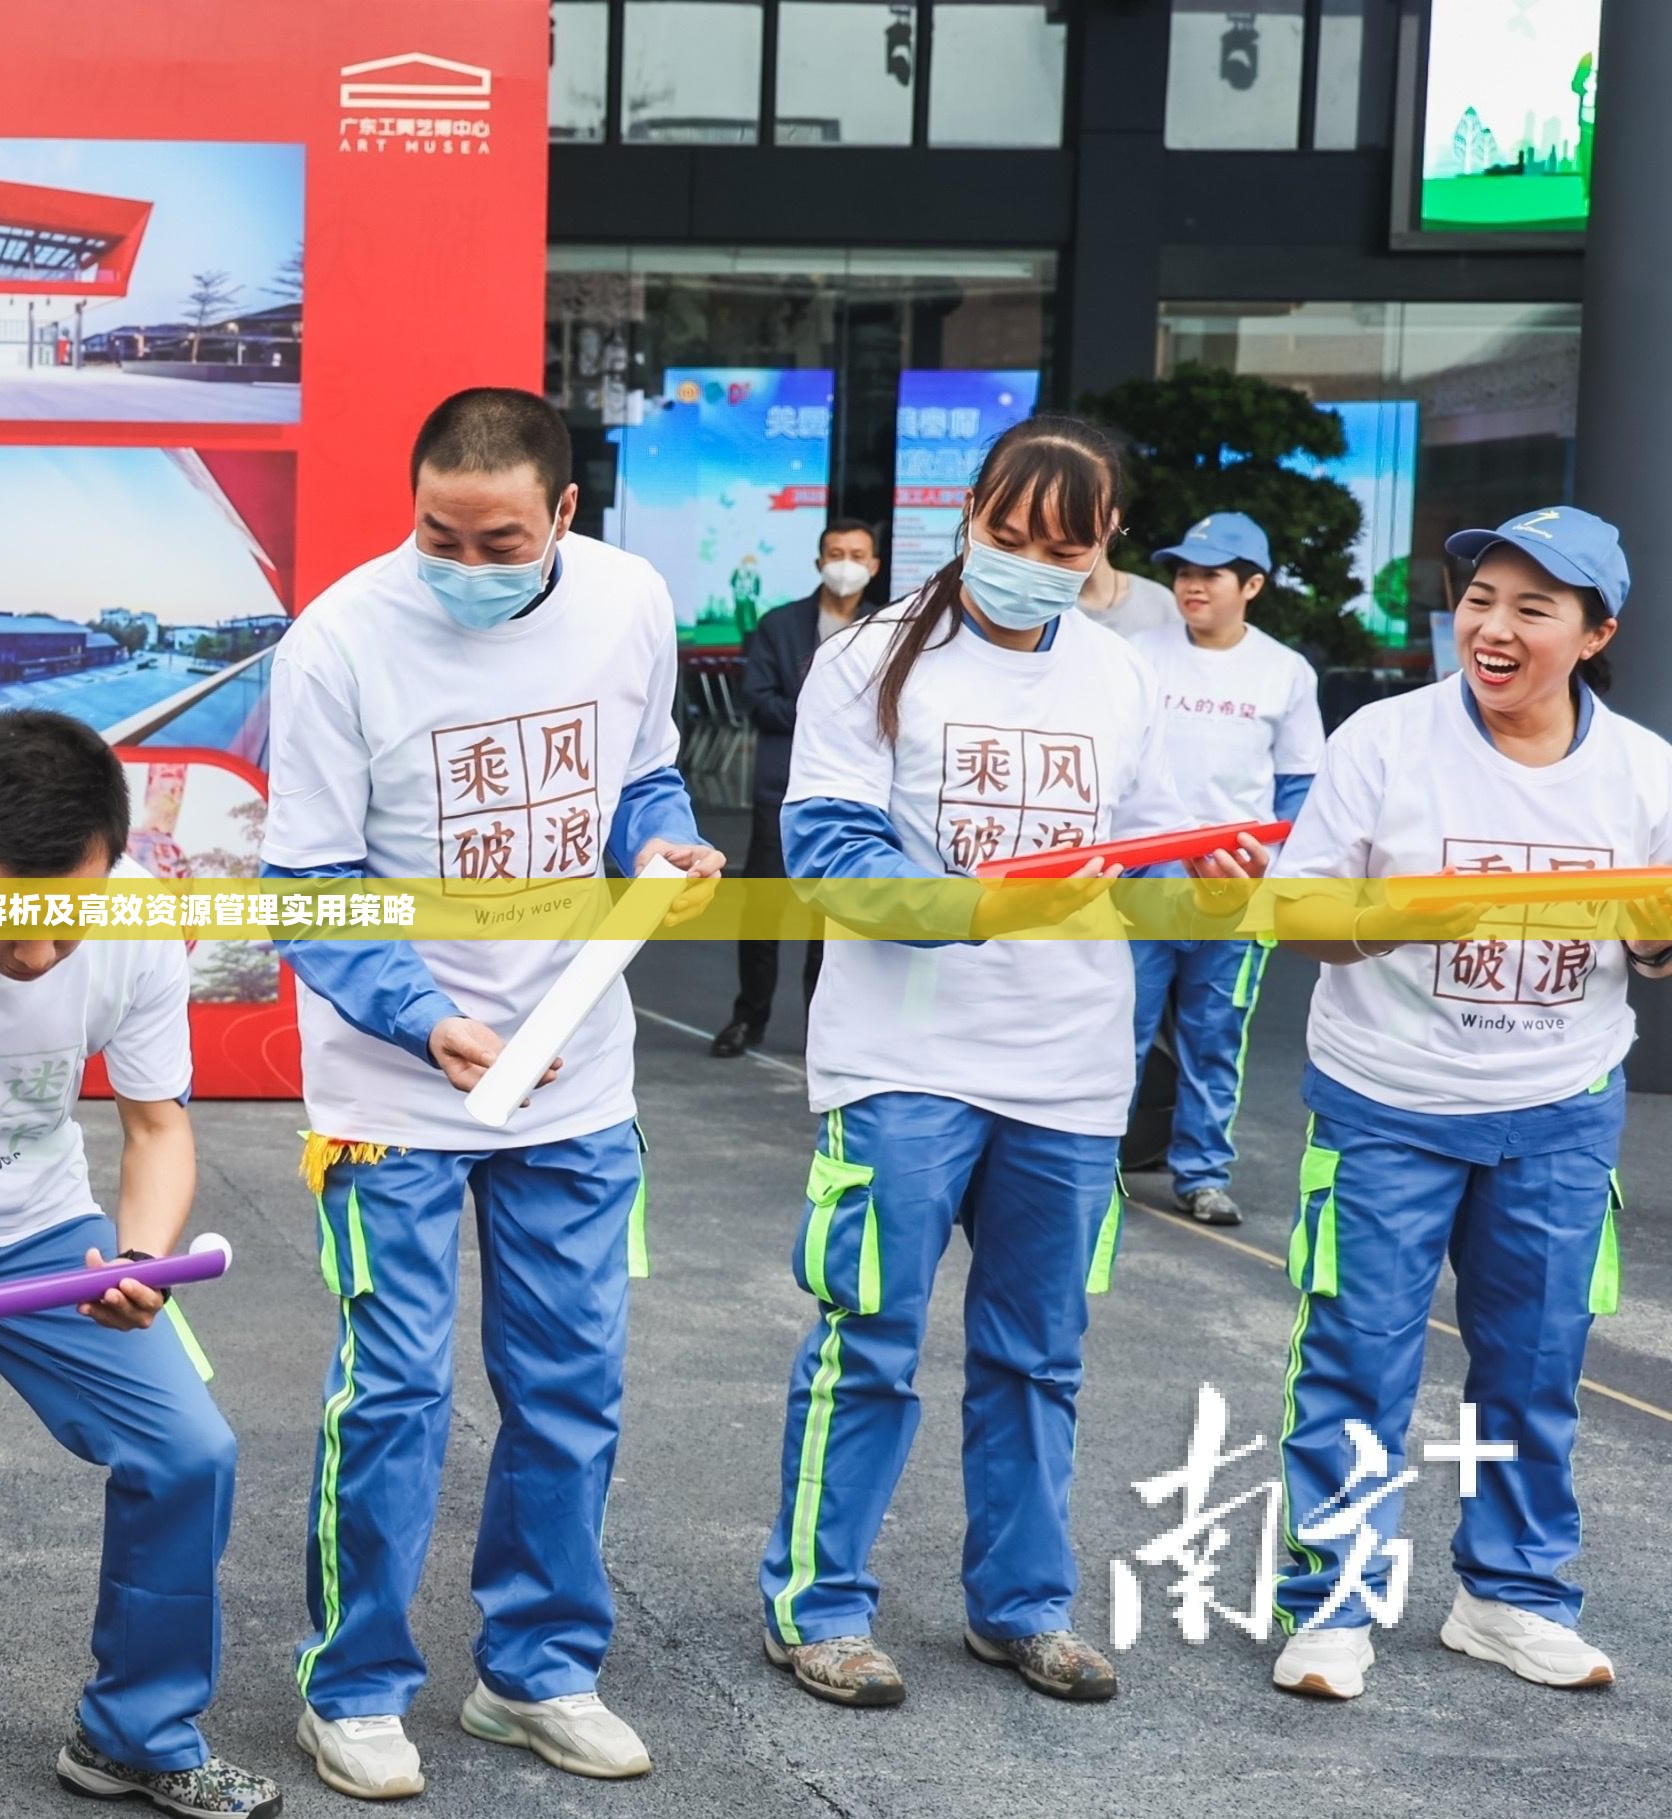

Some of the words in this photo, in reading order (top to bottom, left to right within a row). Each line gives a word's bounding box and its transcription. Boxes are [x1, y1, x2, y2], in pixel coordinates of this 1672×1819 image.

[339, 138, 386, 152] ART
[405, 140, 490, 154] MUSEA
[1164, 694, 1256, 720] 人的希望
[448, 717, 590, 805] 乘风
[945, 738, 1092, 804] 乘风
[452, 806, 594, 886] 破浪
[474, 904, 525, 925] Windy
[531, 897, 572, 916] wave
[1447, 933, 1593, 995] 破浪
[1461, 1012, 1516, 1033] Windy
[1522, 1016, 1565, 1031] wave
